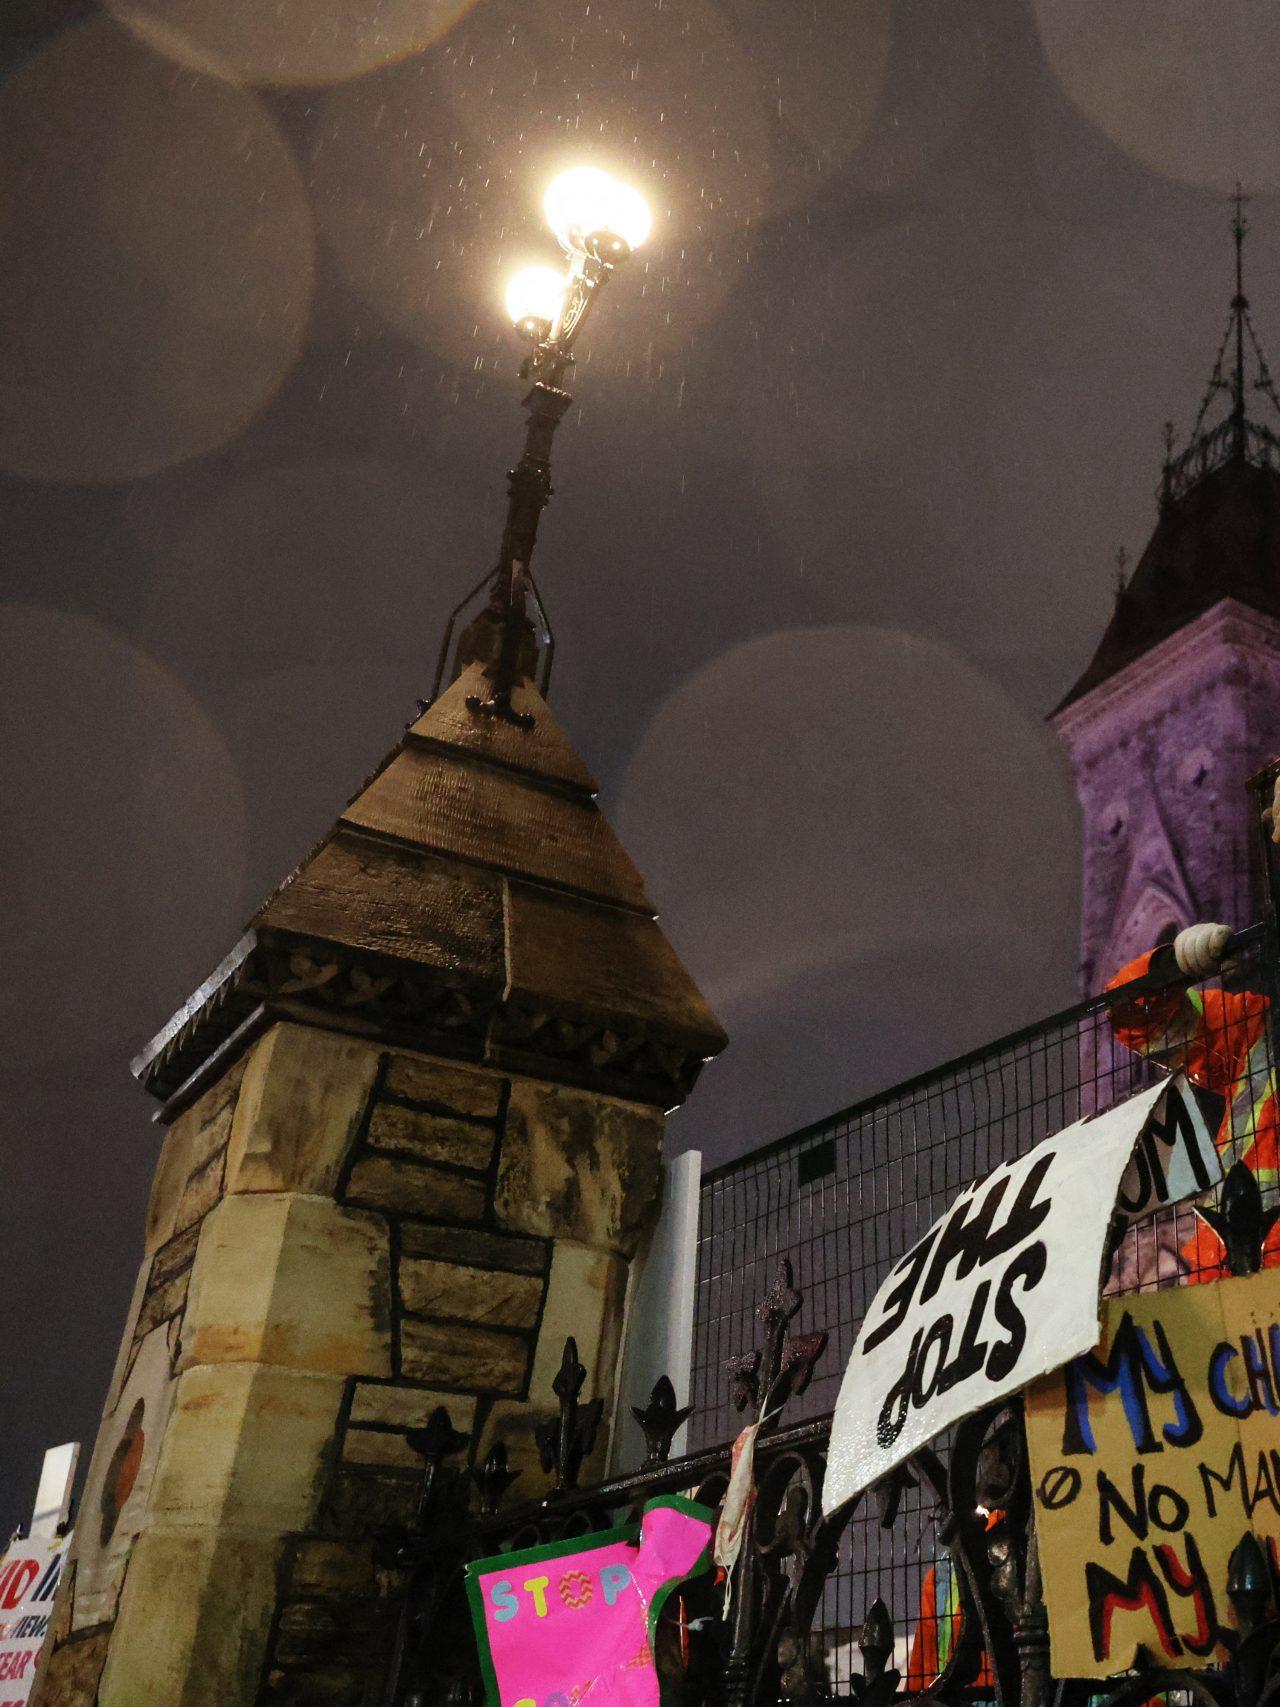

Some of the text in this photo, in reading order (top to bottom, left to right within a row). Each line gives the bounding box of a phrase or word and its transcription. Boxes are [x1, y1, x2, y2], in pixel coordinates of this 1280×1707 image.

[861, 1151, 1057, 1356] THE
[876, 1240, 1048, 1450] STOP
[490, 1563, 631, 1623] STOP
